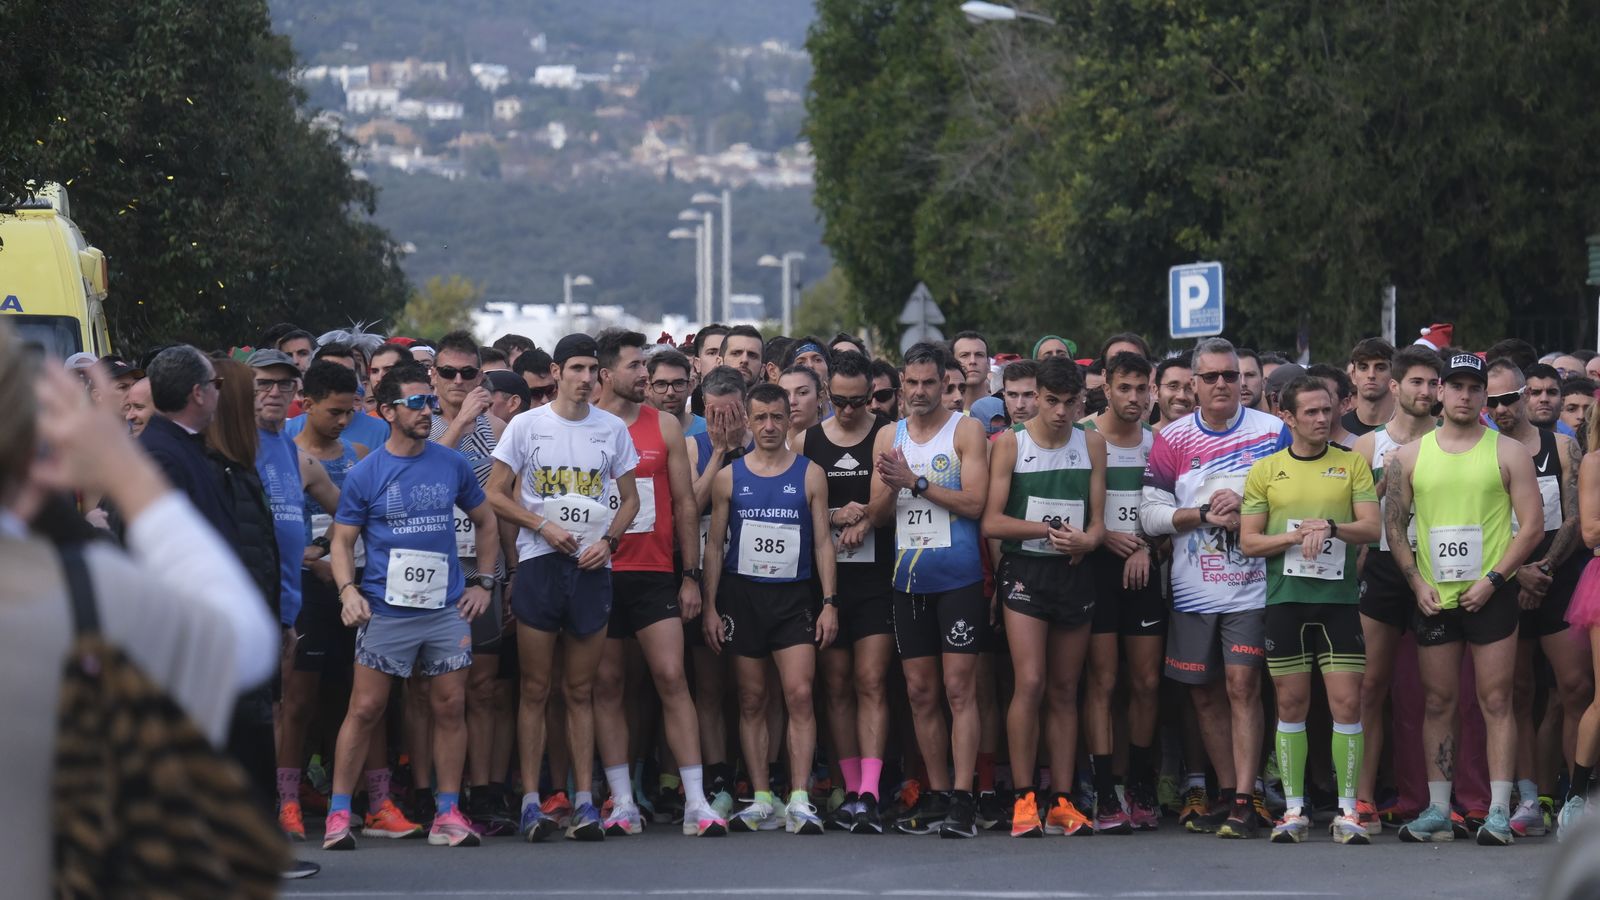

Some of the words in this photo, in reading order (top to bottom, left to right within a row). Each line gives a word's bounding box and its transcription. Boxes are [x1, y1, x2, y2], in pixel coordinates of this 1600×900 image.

[0, 295, 24, 312] A
[1179, 274, 1210, 329] P
[534, 469, 601, 487] SUBIDA
[827, 469, 869, 477] DICCOR.ES
[387, 518, 406, 528] SAN
[407, 514, 450, 526] SILVESTRE
[559, 506, 591, 523] 361
[738, 508, 800, 519] TROTASIERRA
[907, 508, 932, 525] 271
[392, 523, 447, 535] CORDOBESA
[754, 537, 785, 554] 385
[1438, 541, 1468, 558] 266
[404, 566, 436, 583] 697
